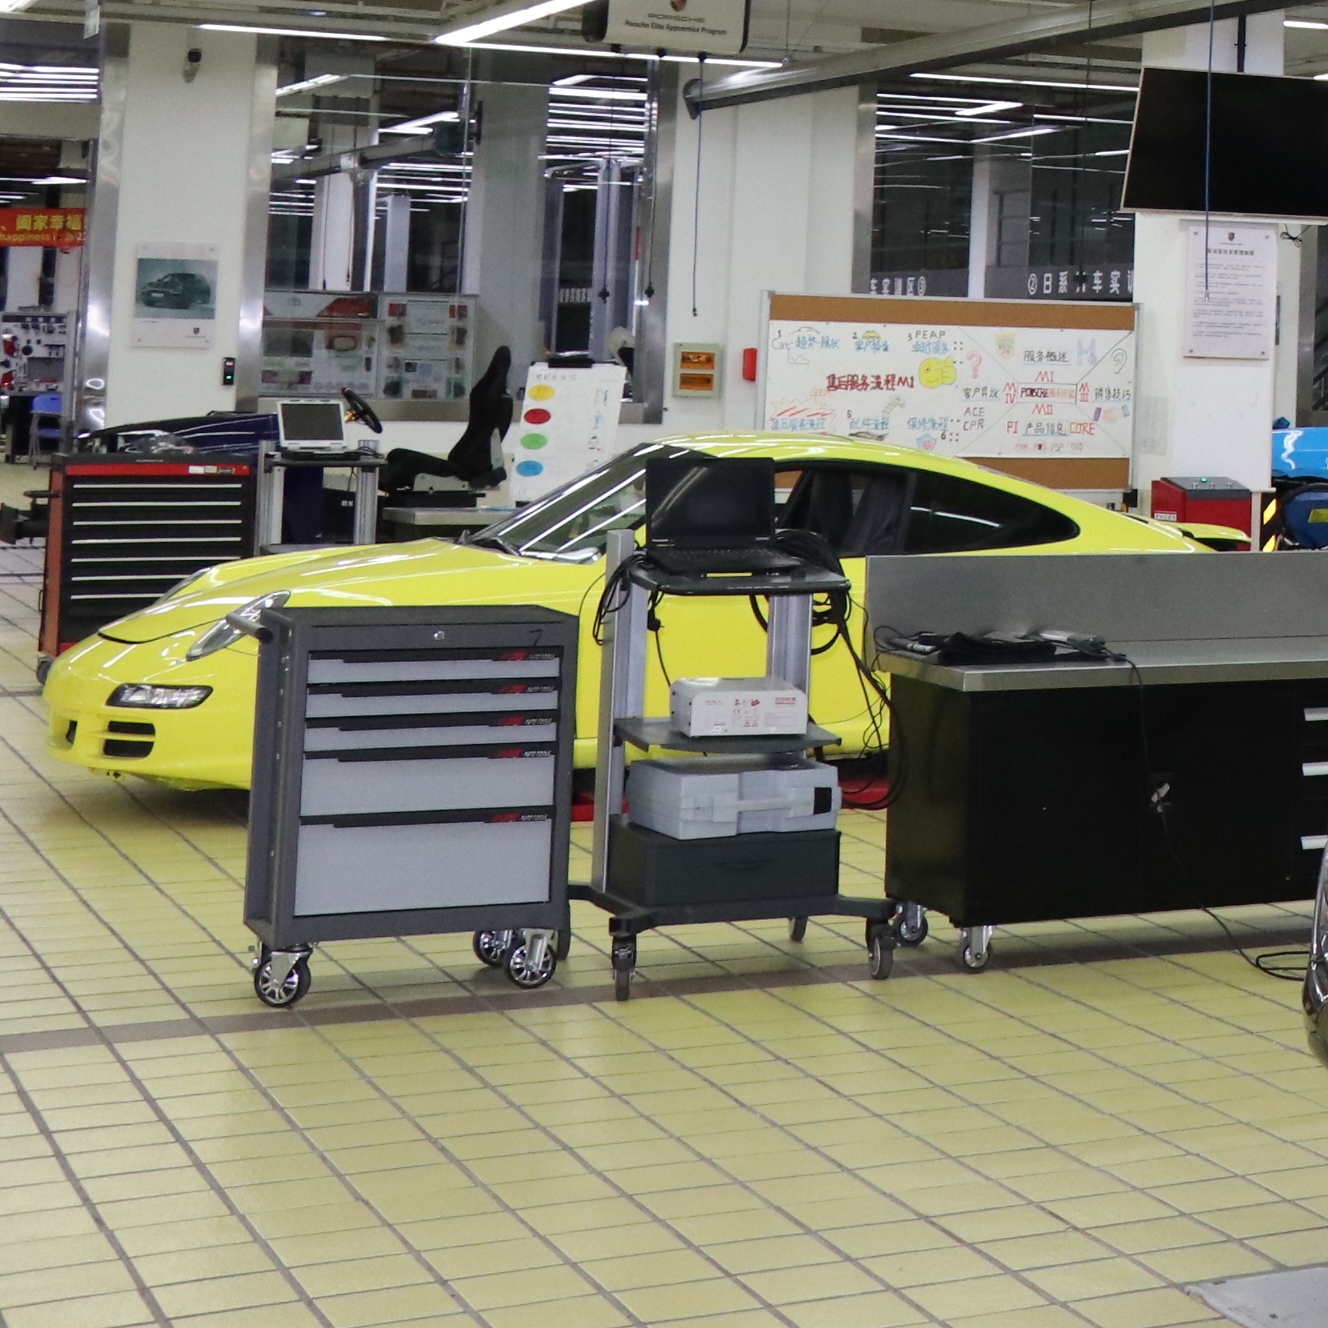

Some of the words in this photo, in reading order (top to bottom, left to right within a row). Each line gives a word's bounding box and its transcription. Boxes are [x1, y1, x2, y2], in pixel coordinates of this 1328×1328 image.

[648, 13, 705, 23] PORSCHE
[625, 20, 649, 29] Porsche
[701, 26, 727, 36] Program
[915, 330, 946, 340] PEAP
[963, 407, 985, 417] ACE
[963, 418, 985, 431] CPR
